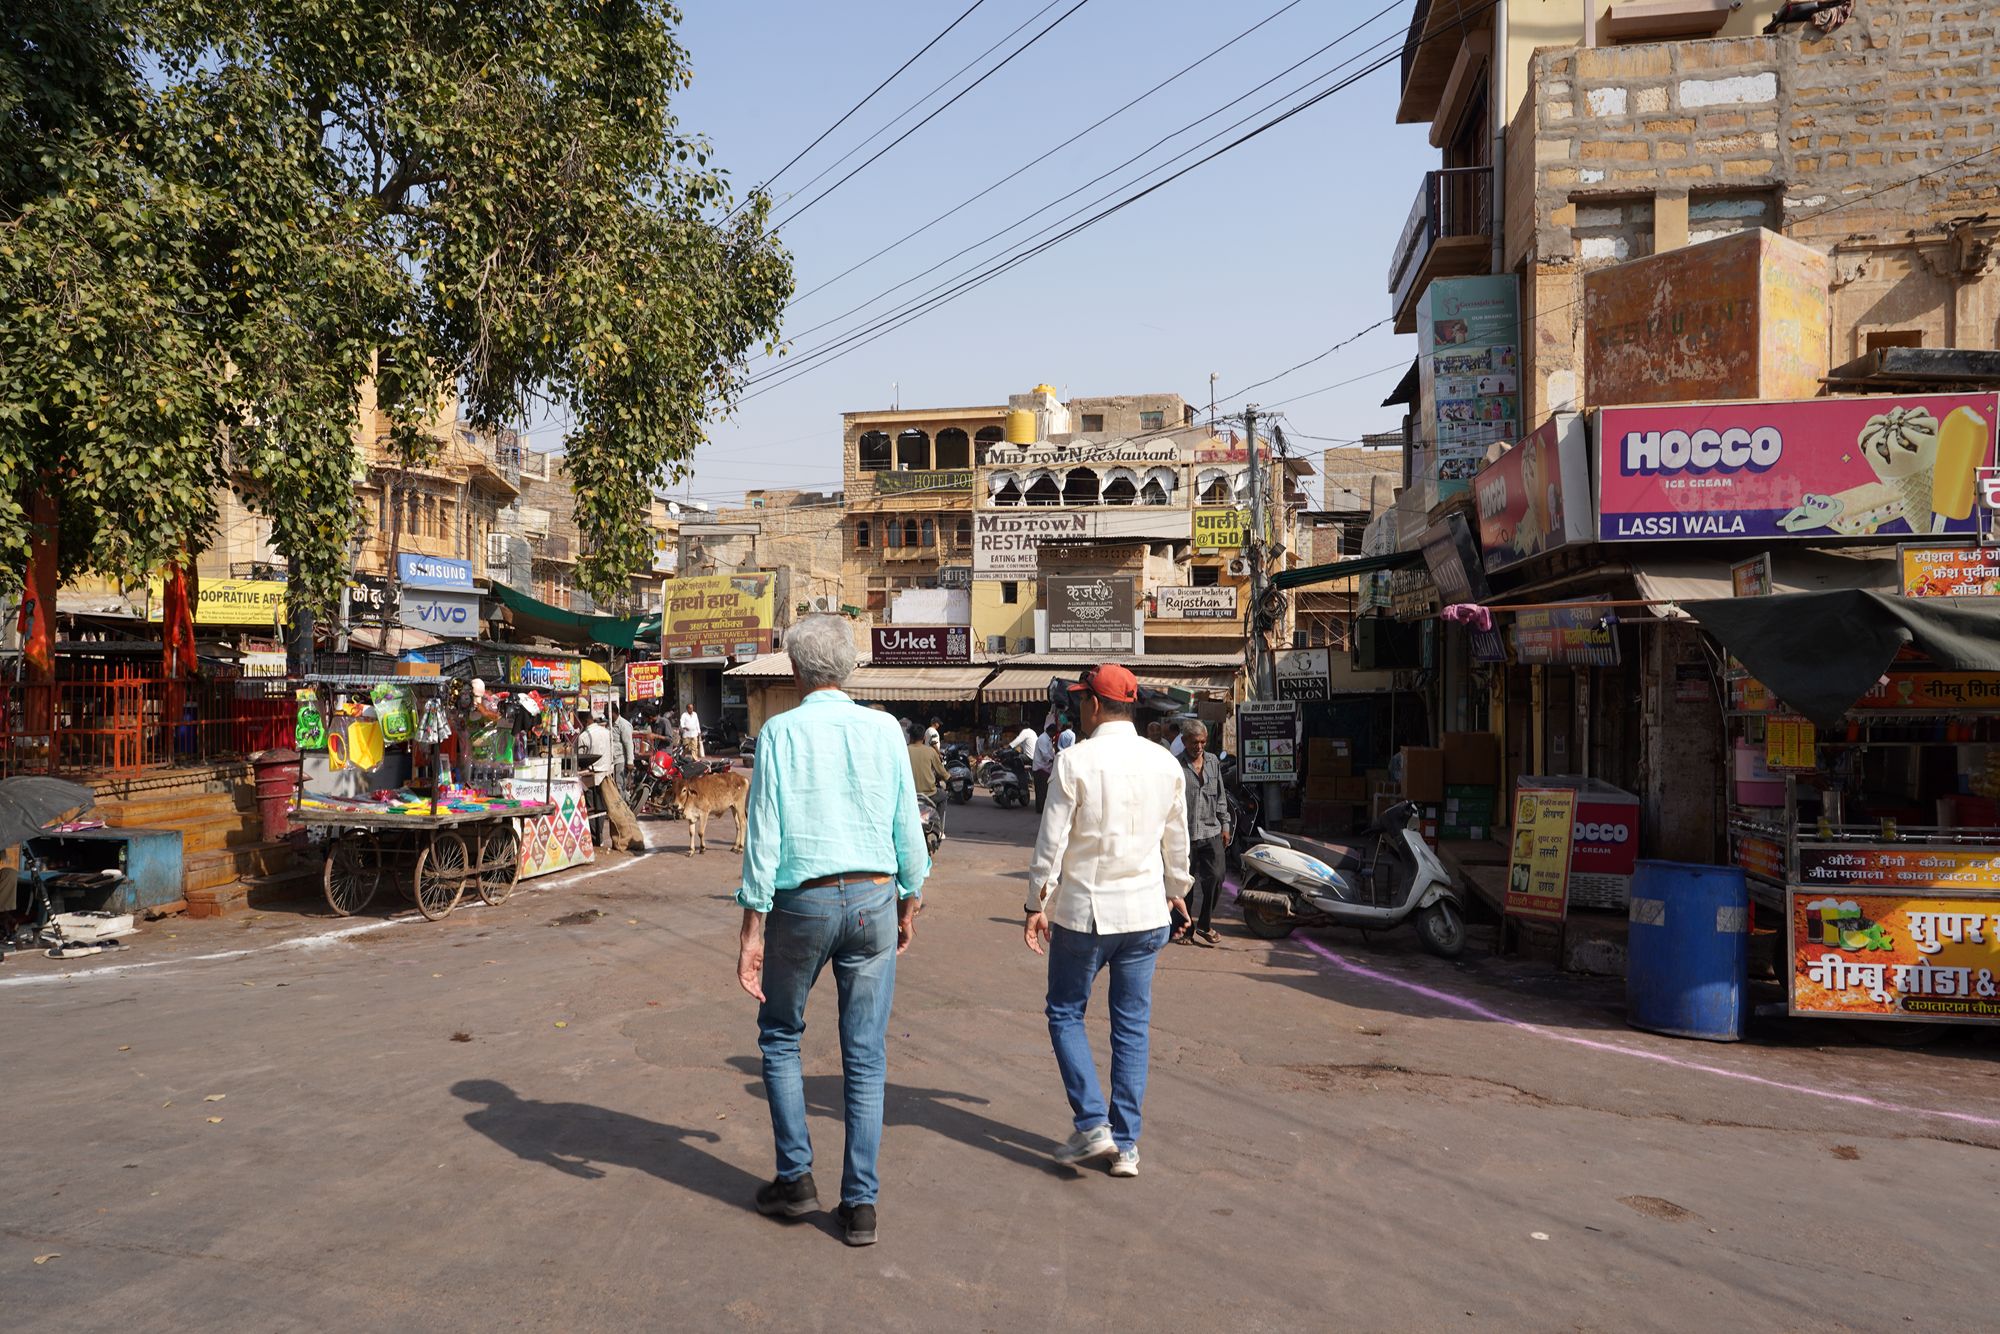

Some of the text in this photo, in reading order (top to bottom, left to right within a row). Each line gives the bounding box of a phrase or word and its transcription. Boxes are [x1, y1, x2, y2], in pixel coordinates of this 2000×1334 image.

[1082, 448, 1177, 464] Restaurant
[1622, 426, 1783, 474] HOCCO
[914, 474, 948, 488] HOTEL
[1665, 478, 1732, 488] ICE CREAM
[1196, 511, 1239, 530] थाली
[1618, 515, 1745, 536] LASSI WALA
[990, 554, 1016, 563] EATING
[409, 562, 466, 579] SAMSUNG
[941, 569, 969, 581] HOTEL
[1177, 588, 1201, 597] Discover
[1951, 582, 1982, 595] सोडा
[198, 590, 260, 604] OOPRATIVE
[1165, 596, 1221, 610] Rajasthan
[416, 600, 467, 623] vivo
[703, 632, 719, 640] VIEW
[721, 630, 749, 638] TRAVELS
[880, 630, 937, 650] Urket
[1281, 678, 1325, 690] UNISEX
[1284, 690, 1323, 701] SALON
[1261, 703, 1276, 711] FRUITS
[1574, 822, 1629, 843] OCCO
[1582, 847, 1612, 855] CREAM
[1808, 866, 1837, 879] जीरा
[1839, 869, 1884, 880] मसाला
[1906, 911, 1986, 954] सुपर
[1807, 953, 1996, 1003] नीम्बू सोडा &
